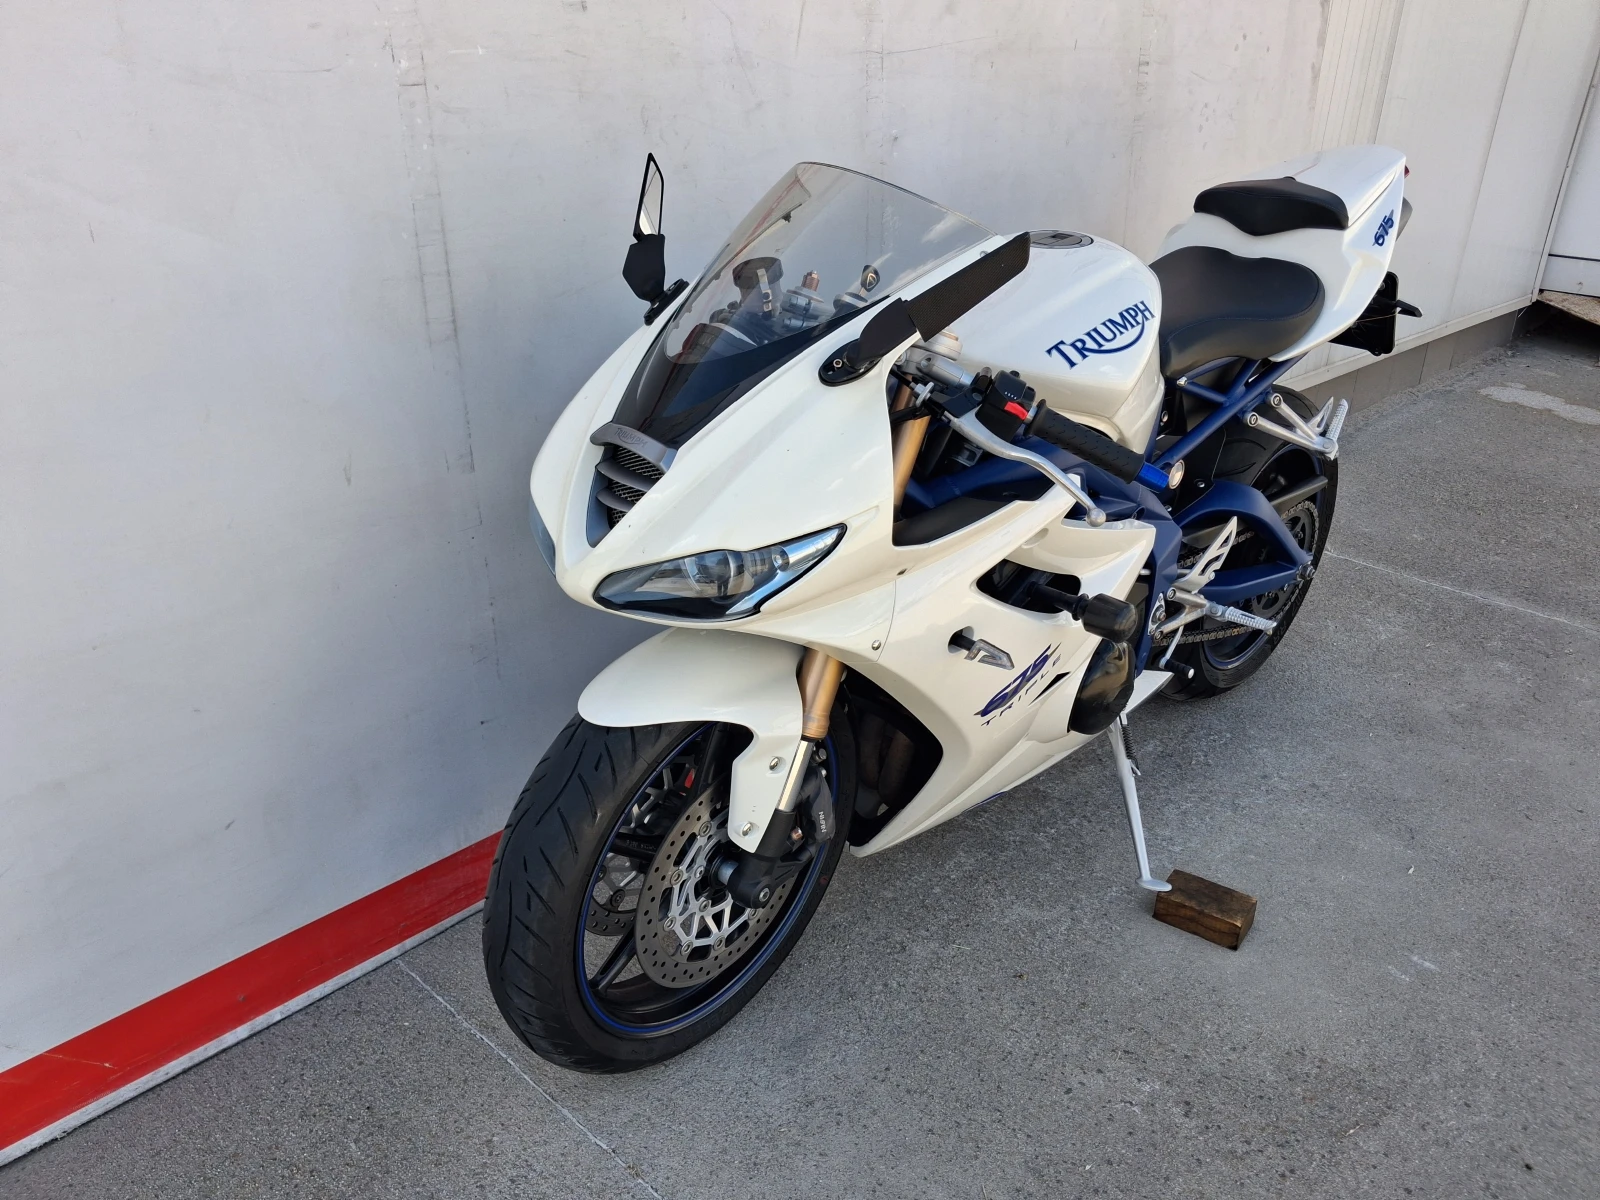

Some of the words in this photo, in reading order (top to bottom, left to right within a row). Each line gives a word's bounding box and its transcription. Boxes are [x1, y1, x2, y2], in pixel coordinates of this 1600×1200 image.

[1373, 214, 1395, 247] 675
[1045, 300, 1156, 370] TRIUMPH
[614, 427, 648, 448] TRIUMPH
[980, 643, 1053, 718] 675
[980, 653, 1062, 727] TRIPLE
